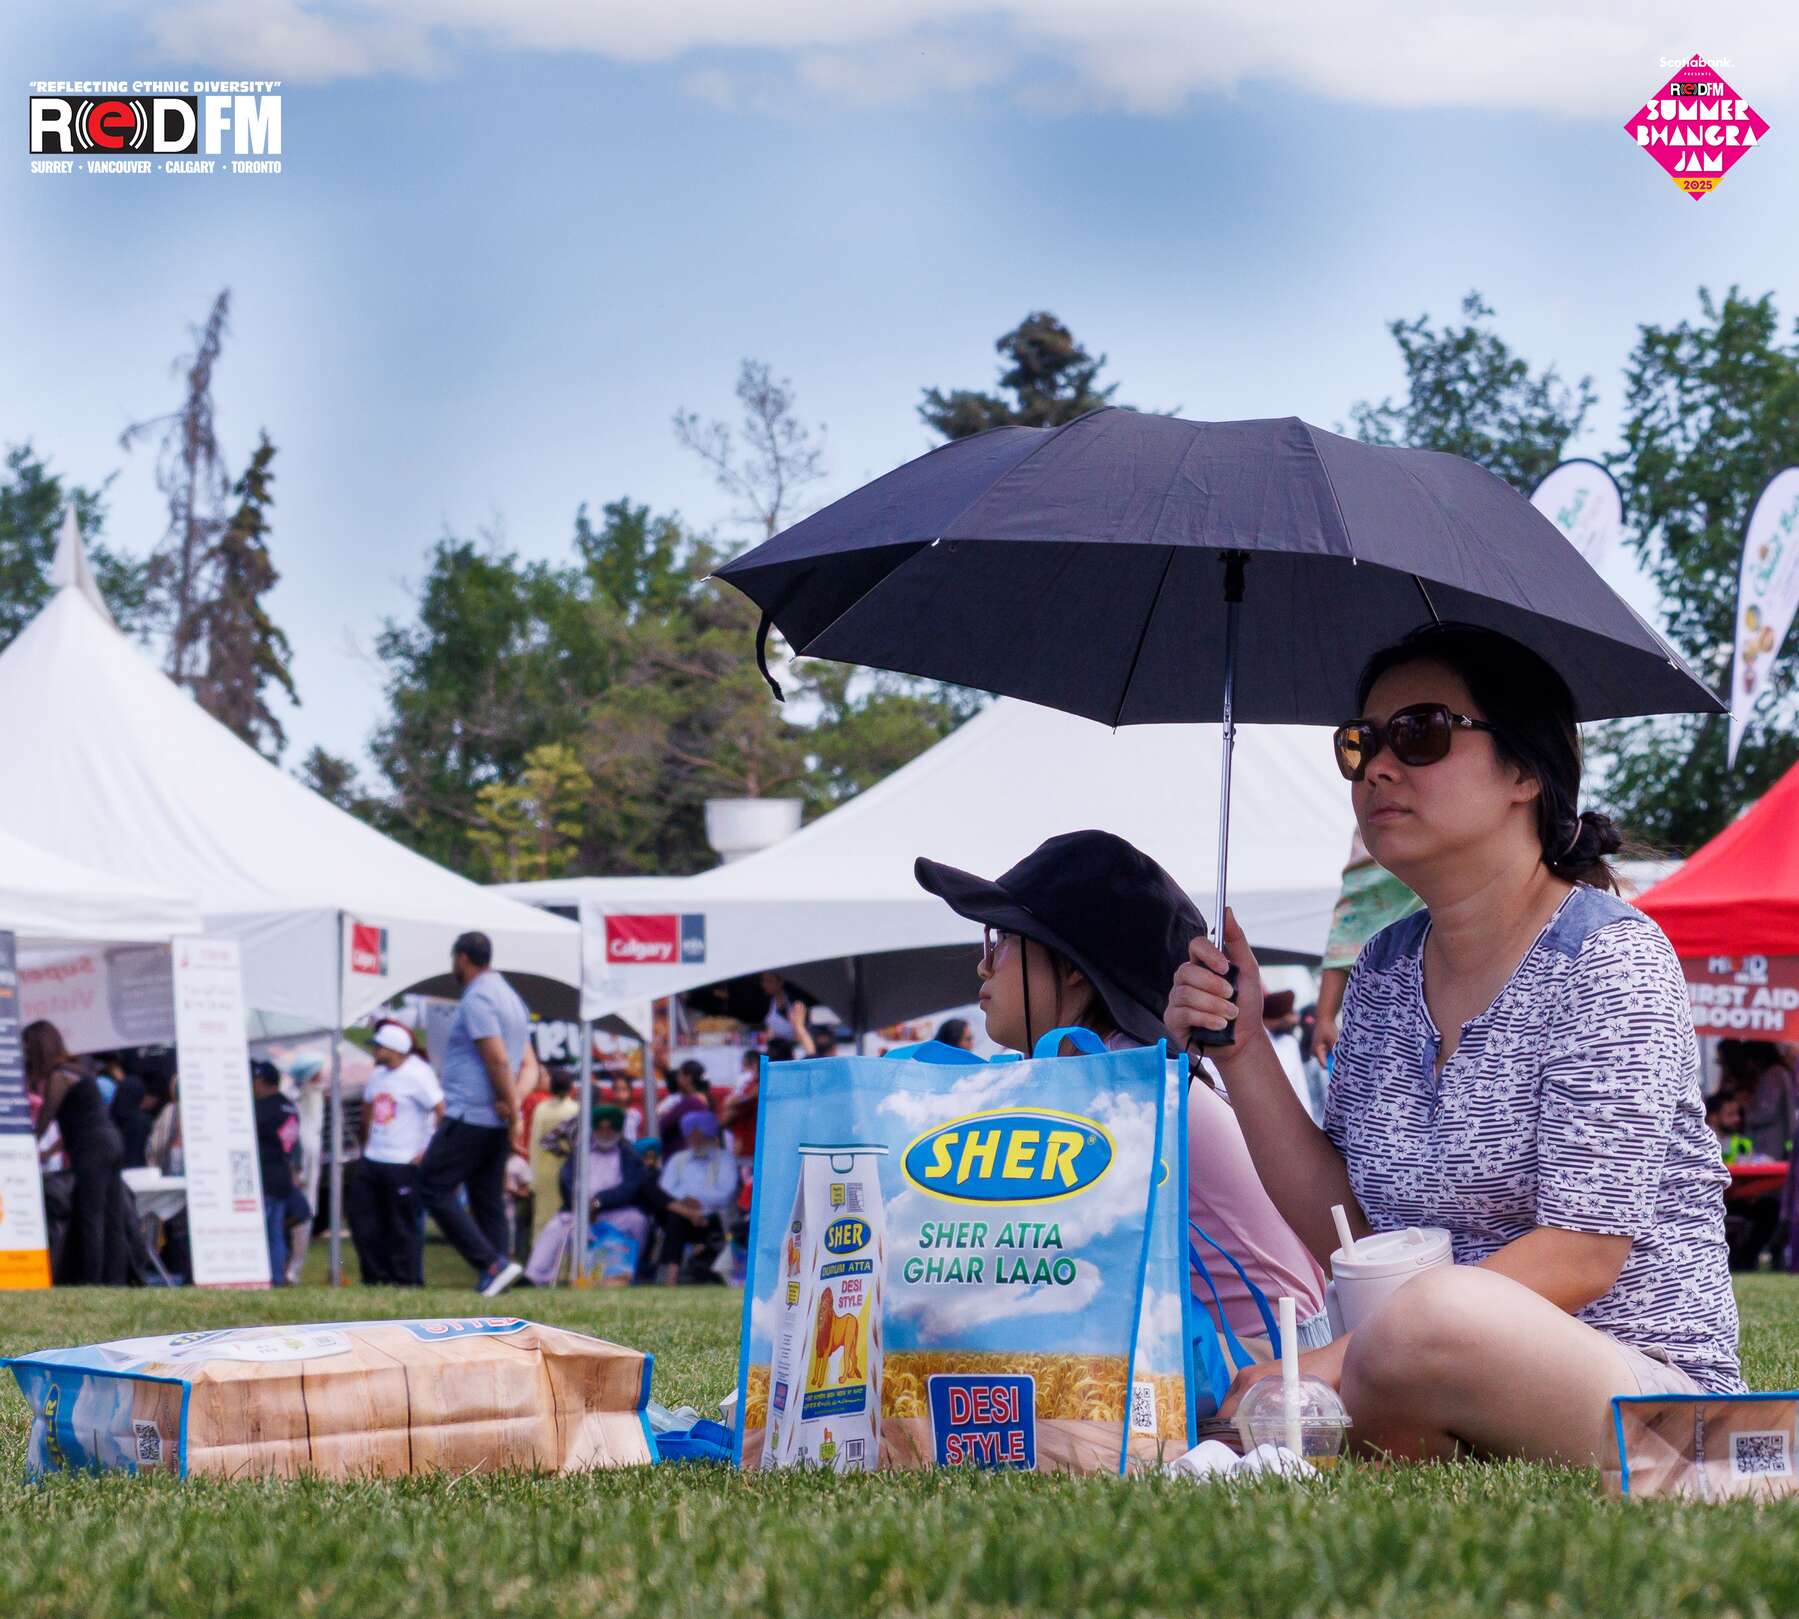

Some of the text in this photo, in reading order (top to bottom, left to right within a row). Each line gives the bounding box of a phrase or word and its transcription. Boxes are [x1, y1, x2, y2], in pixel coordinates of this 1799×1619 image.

[610, 937, 673, 960] Calgary
[1687, 982, 1799, 1011] IRST AID
[1693, 1005, 1785, 1031] BOOTH
[828, 1223, 863, 1248] SHER
[919, 1221, 1063, 1249] SHER ATTA
[848, 1261, 871, 1272] ATTA
[903, 1256, 1078, 1286] GHAR LAAO
[841, 1279, 862, 1293] DESI
[838, 1294, 863, 1308] STYLE
[948, 1385, 1020, 1425] DESI
[945, 1430, 1026, 1466] STYLE
